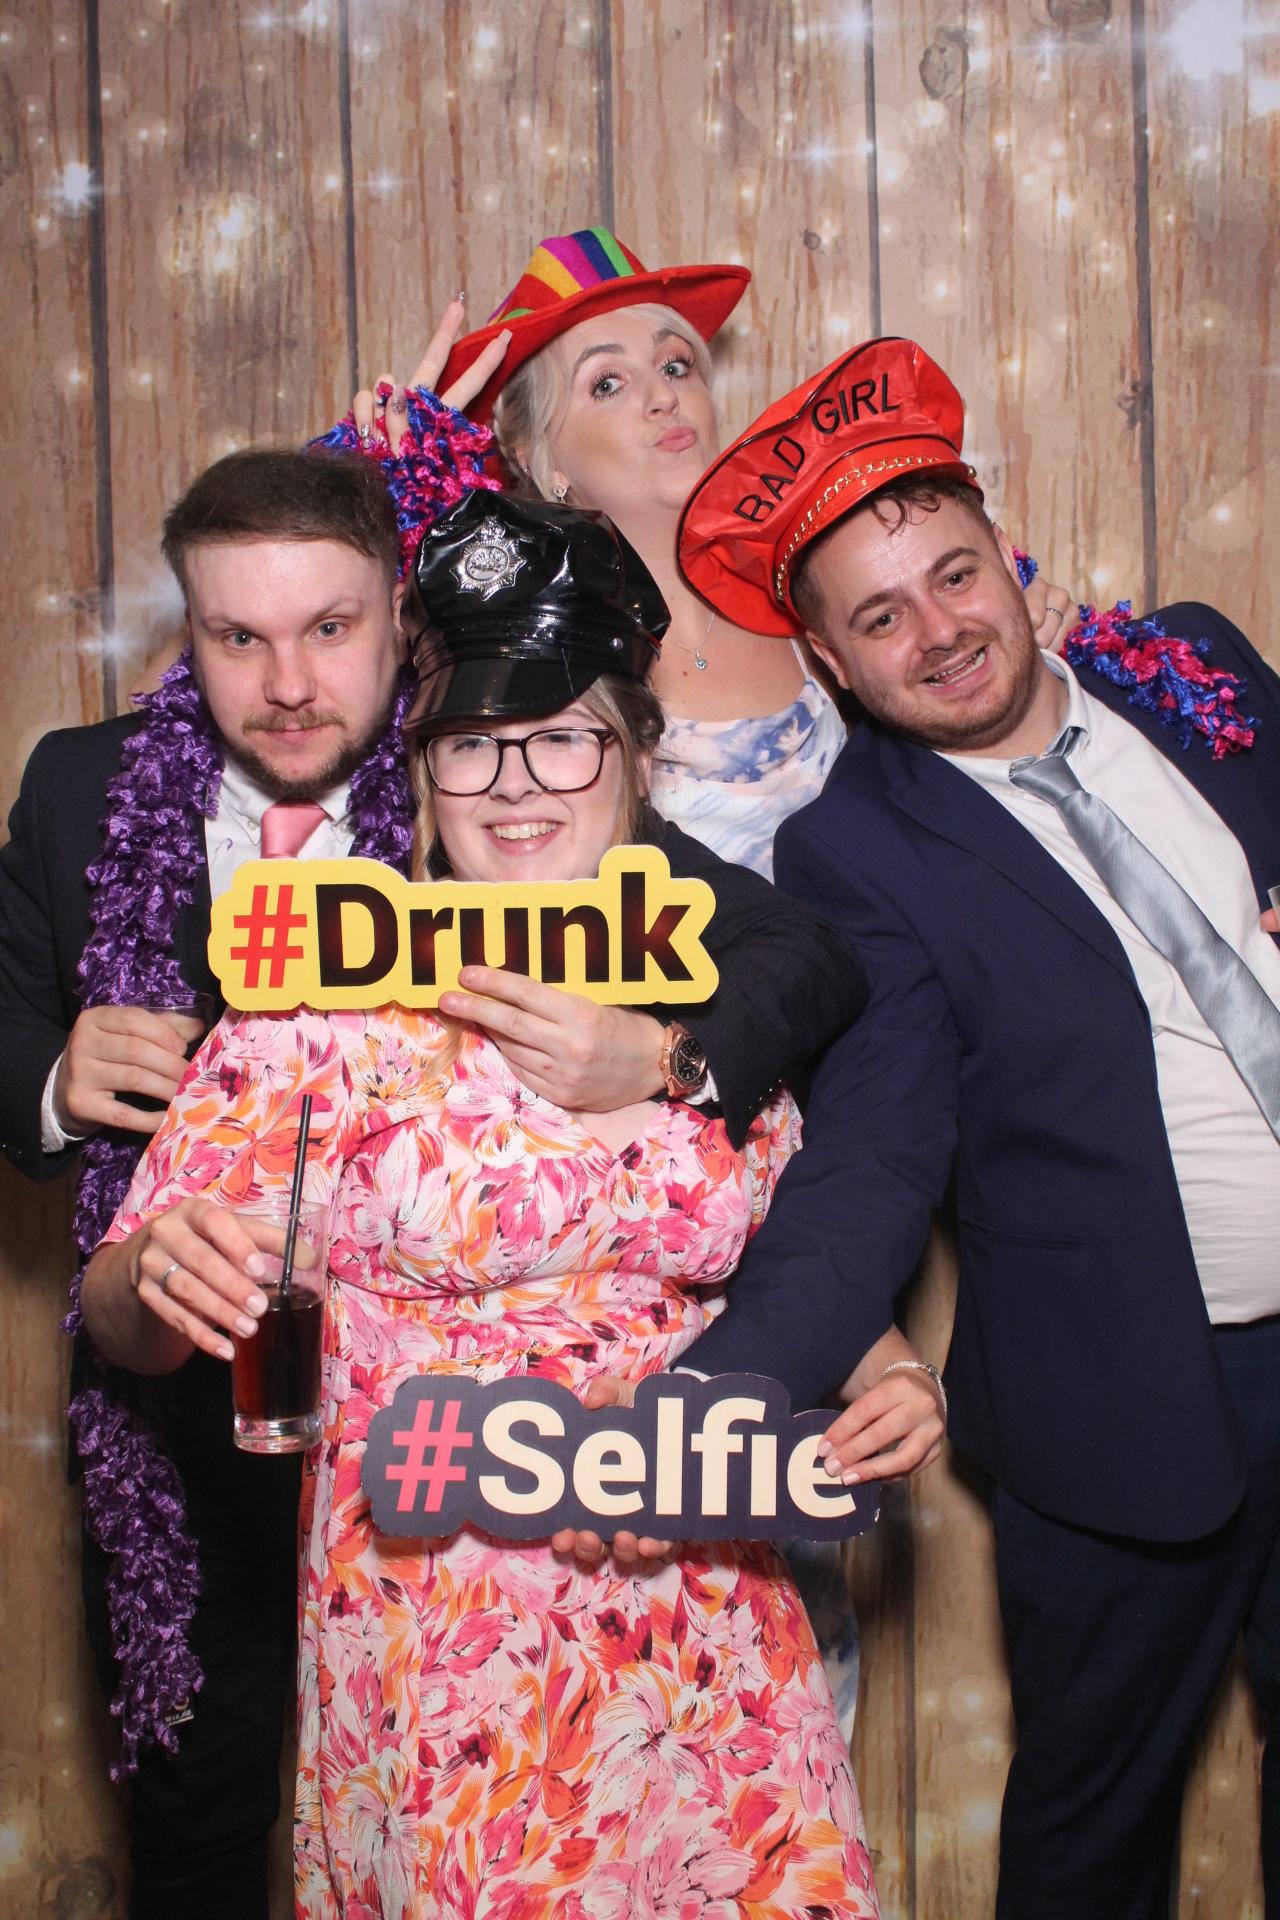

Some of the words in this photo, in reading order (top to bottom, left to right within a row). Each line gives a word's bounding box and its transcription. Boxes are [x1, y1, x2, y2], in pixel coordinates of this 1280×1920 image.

[733, 435, 806, 522] BAD
[811, 373, 901, 435] GIRL
[230, 871, 694, 987] #Drunk
[386, 1397, 857, 1517] #Selfie
